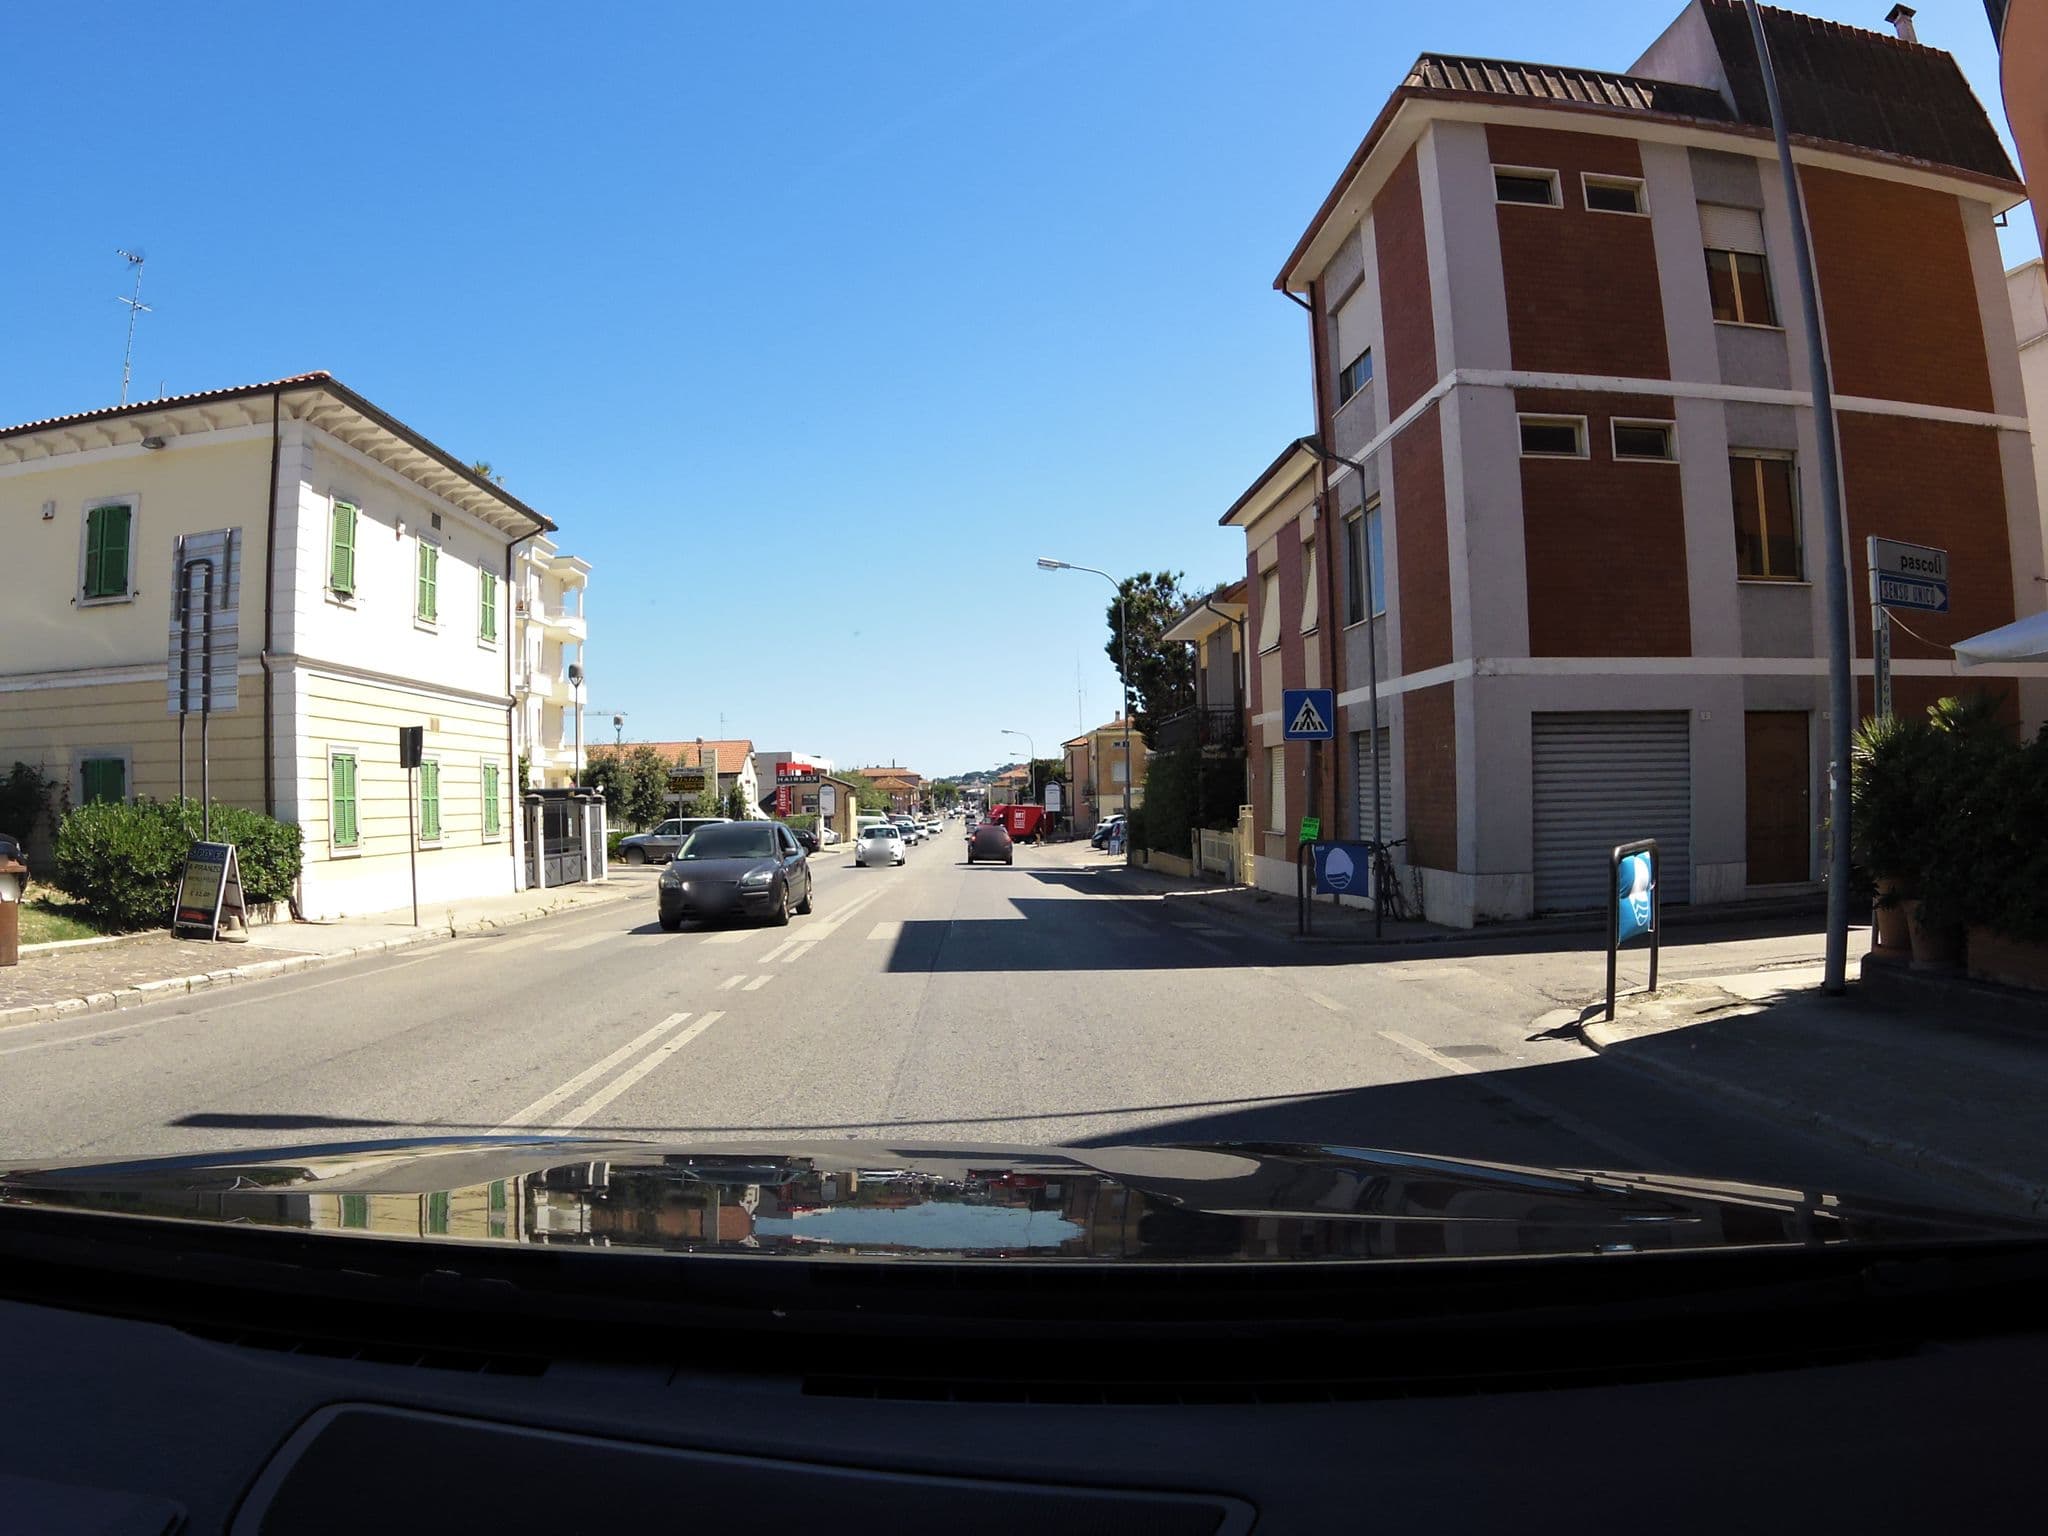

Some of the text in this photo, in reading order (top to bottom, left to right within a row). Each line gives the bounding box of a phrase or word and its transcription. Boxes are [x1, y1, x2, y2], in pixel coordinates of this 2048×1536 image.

[1901, 553, 1942, 575] pascoli
[1883, 581, 1937, 604] SENSO UNICO
